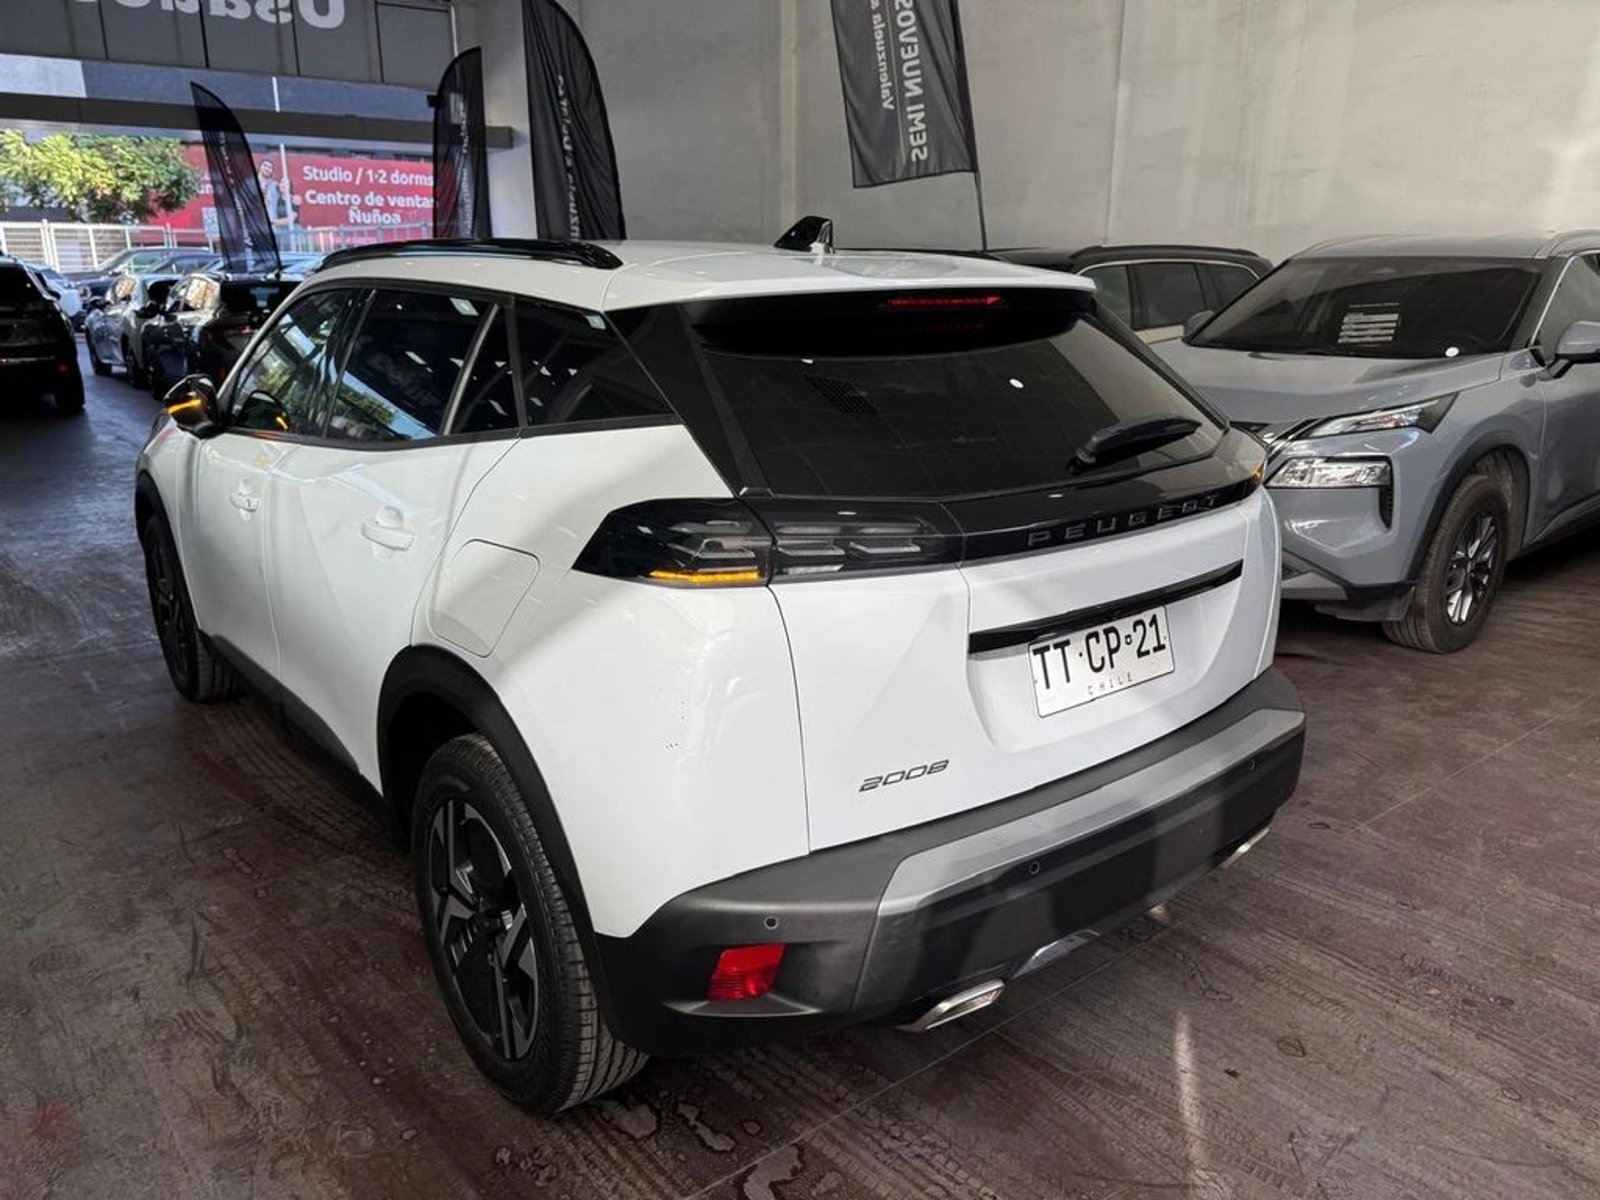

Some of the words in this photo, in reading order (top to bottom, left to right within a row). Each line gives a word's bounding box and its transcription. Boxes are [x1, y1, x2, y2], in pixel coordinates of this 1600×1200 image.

[303, 165, 352, 182] Studio
[305, 189, 361, 206] Centro
[365, 191, 384, 206] de
[349, 206, 401, 225] Ñuñoa
[1027, 494, 1219, 547] PEUGEOT
[1088, 672, 1132, 695] CHILE
[859, 759, 949, 793] 2008
